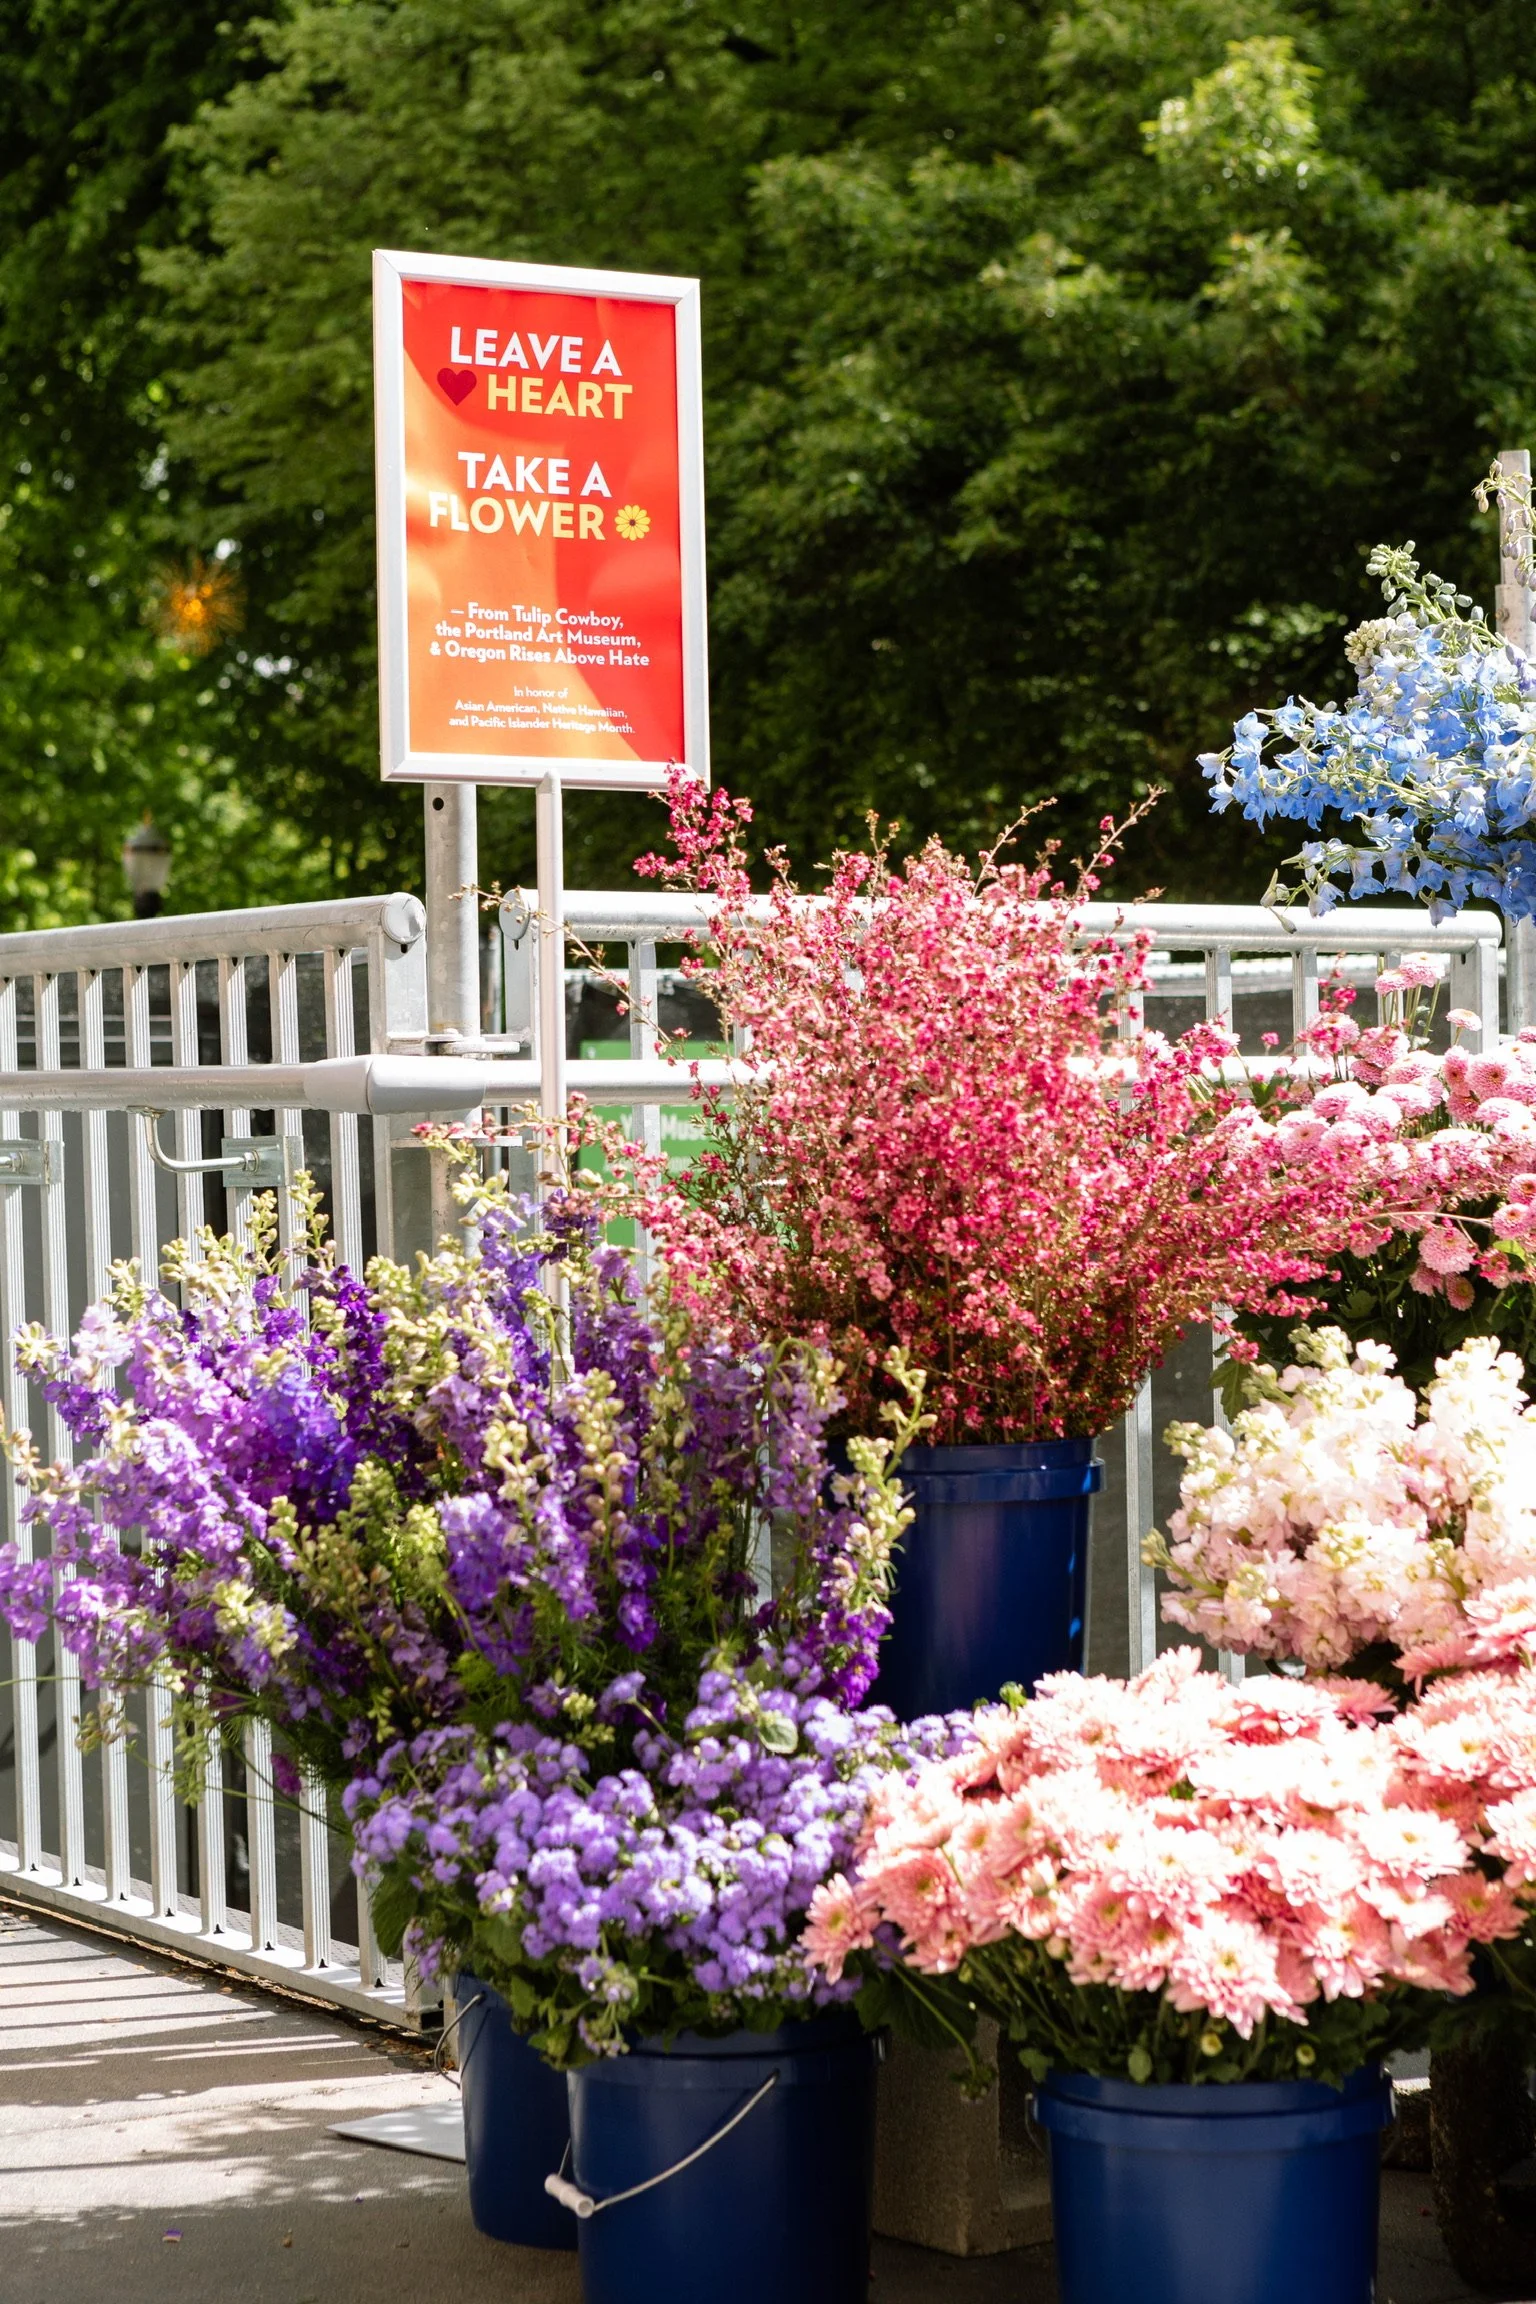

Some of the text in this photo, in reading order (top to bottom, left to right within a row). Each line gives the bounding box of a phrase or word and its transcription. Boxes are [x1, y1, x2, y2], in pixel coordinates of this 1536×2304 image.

[450, 326, 623, 376] LEAVE A
[487, 373, 633, 419] HEART
[457, 451, 612, 498] TAKE A
[428, 490, 606, 541] FLOWER
[468, 601, 509, 621] From
[512, 604, 552, 627] Tulip
[555, 608, 624, 630] Cowboy,
[435, 620, 641, 648] the Portland Art Museum,
[430, 640, 650, 666] & Oregon Rises Above Hate
[513, 686, 568, 699] In honor of
[455, 699, 628, 719] Asian American, Native Hawaiian,
[449, 715, 636, 734] and Pacific Islander Heritage Month.
